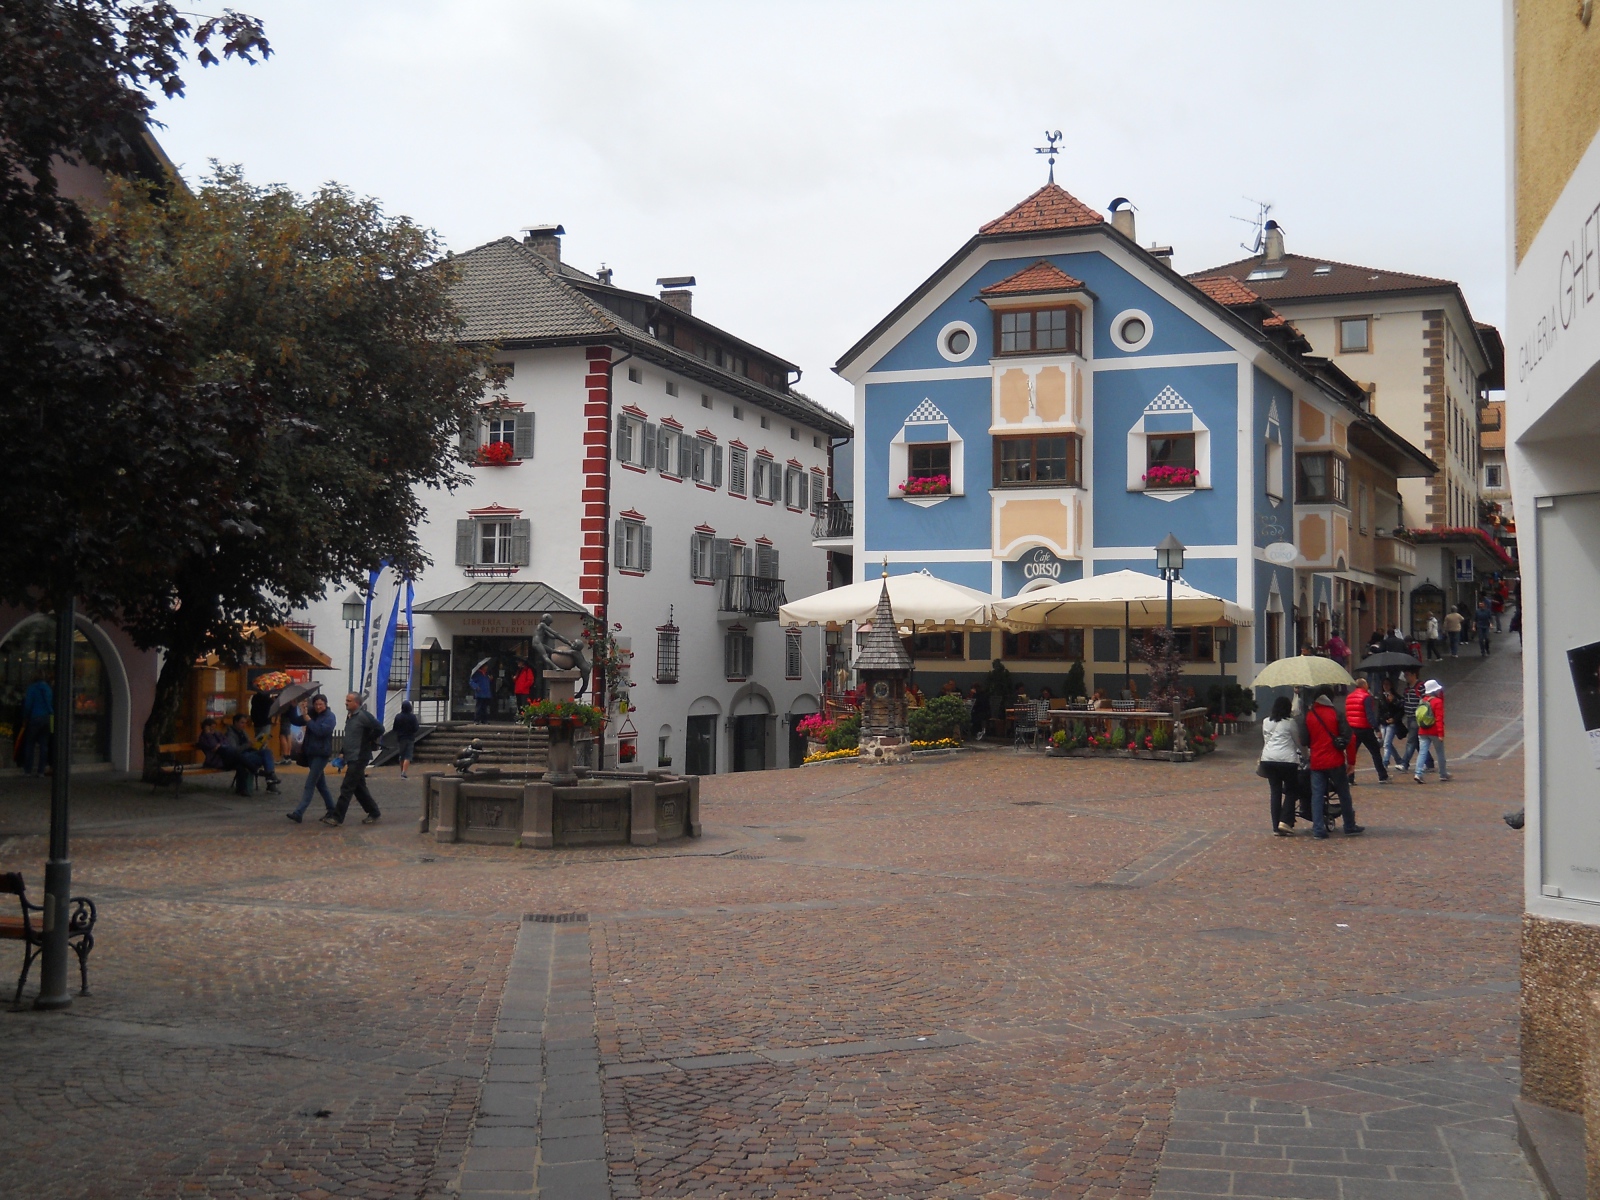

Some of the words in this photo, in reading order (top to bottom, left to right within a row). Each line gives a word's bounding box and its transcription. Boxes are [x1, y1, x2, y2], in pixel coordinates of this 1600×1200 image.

[1518, 305, 1557, 384] GALLERIA
[1024, 562, 1061, 578] CORSO
[463, 618, 501, 626] LIBRERIA
[481, 626, 525, 634] PAPETERIE
